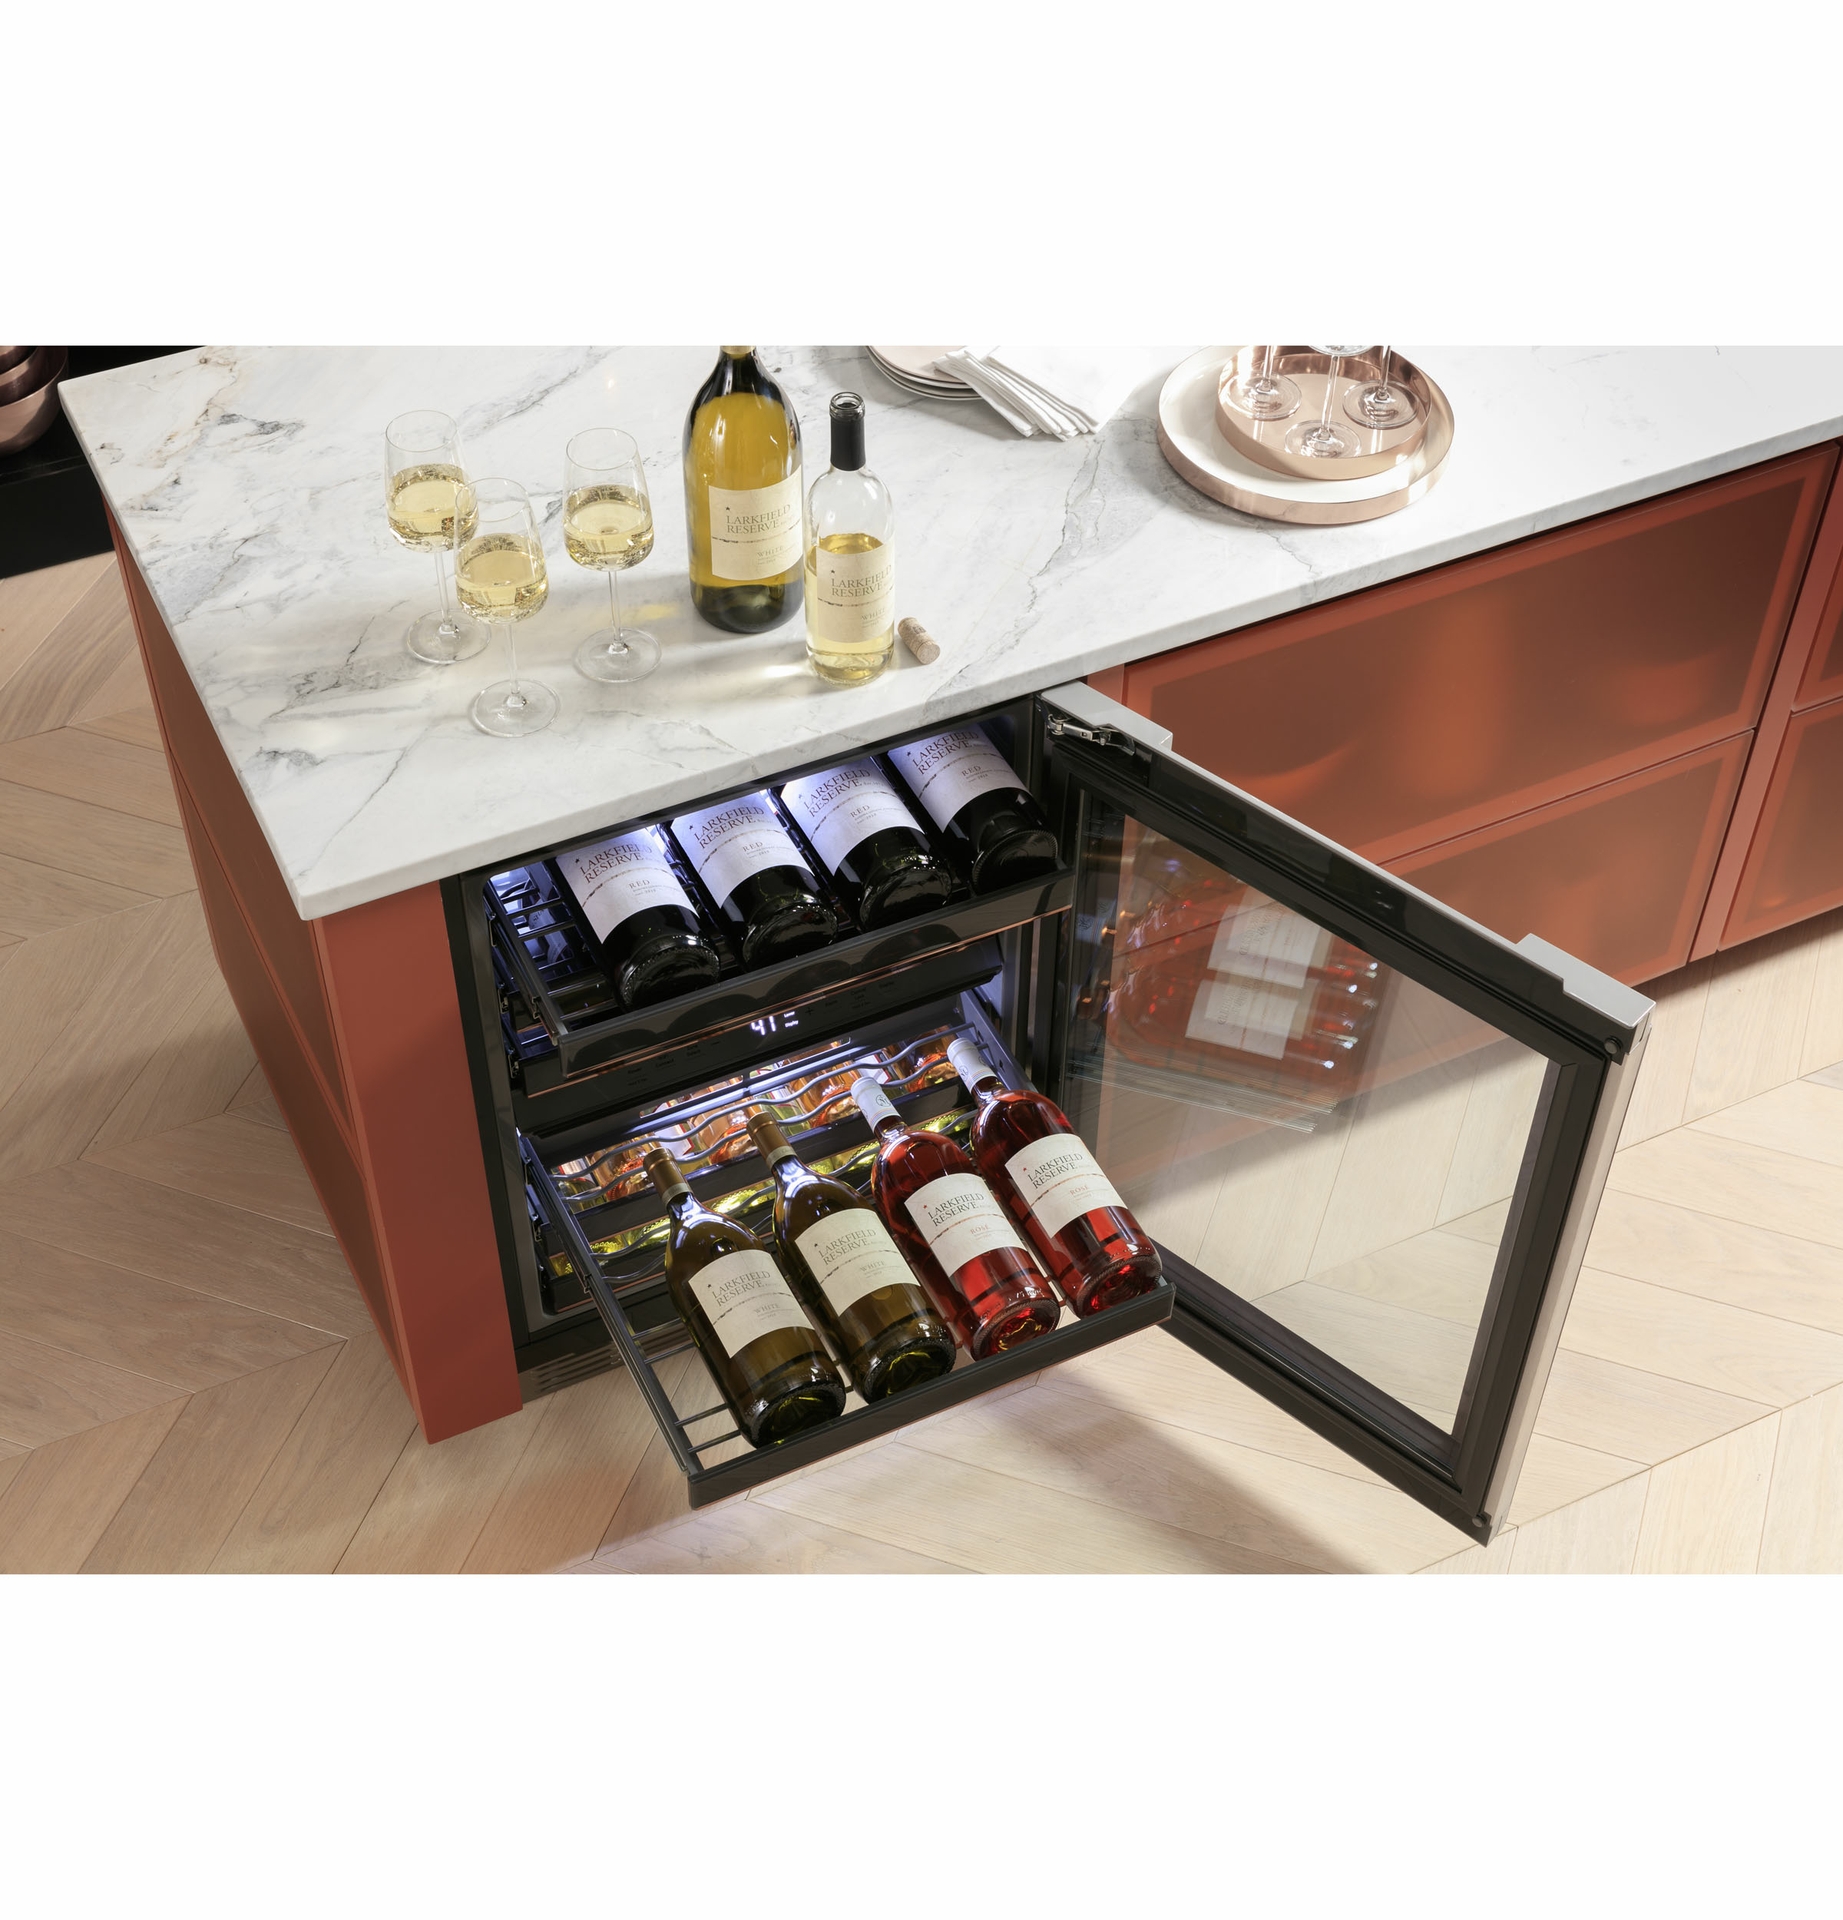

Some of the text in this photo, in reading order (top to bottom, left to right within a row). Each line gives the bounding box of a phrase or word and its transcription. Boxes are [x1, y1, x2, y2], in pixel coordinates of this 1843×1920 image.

[726, 504, 791, 524] LARKFIELD
[727, 520, 780, 534] RESERVE
[756, 546, 784, 557] WHITE
[831, 564, 892, 588] LARKFIELD
[831, 581, 883, 597] RESERVE
[912, 731, 979, 767] LARKFIELD
[918, 740, 972, 775] RESERVE
[961, 766, 981, 777] RED
[803, 769, 871, 809] LARKFIELD
[809, 778, 862, 817] RESERVE
[694, 806, 765, 840] LARKFIELD
[850, 805, 870, 818] RED
[699, 815, 756, 849] RESERVE
[580, 843, 653, 874] LARKFIELD
[742, 841, 763, 852] RED
[584, 852, 644, 884] RESERVE
[629, 879, 650, 889] RED
[749, 1015, 777, 1036] 41
[1027, 1153, 1083, 1181] LARKFIELD
[1032, 1162, 1077, 1189] RESERVE
[928, 1193, 984, 1219] LARKFIELD
[932, 1201, 978, 1226] RESERVE
[818, 1229, 876, 1258] LARKFIELD
[823, 1238, 870, 1265] RESERVE
[860, 1261, 886, 1272] WHITE
[712, 1270, 771, 1299] LARKFIELD
[716, 1280, 763, 1307] RESERVE
[754, 1303, 780, 1314] WHITE
